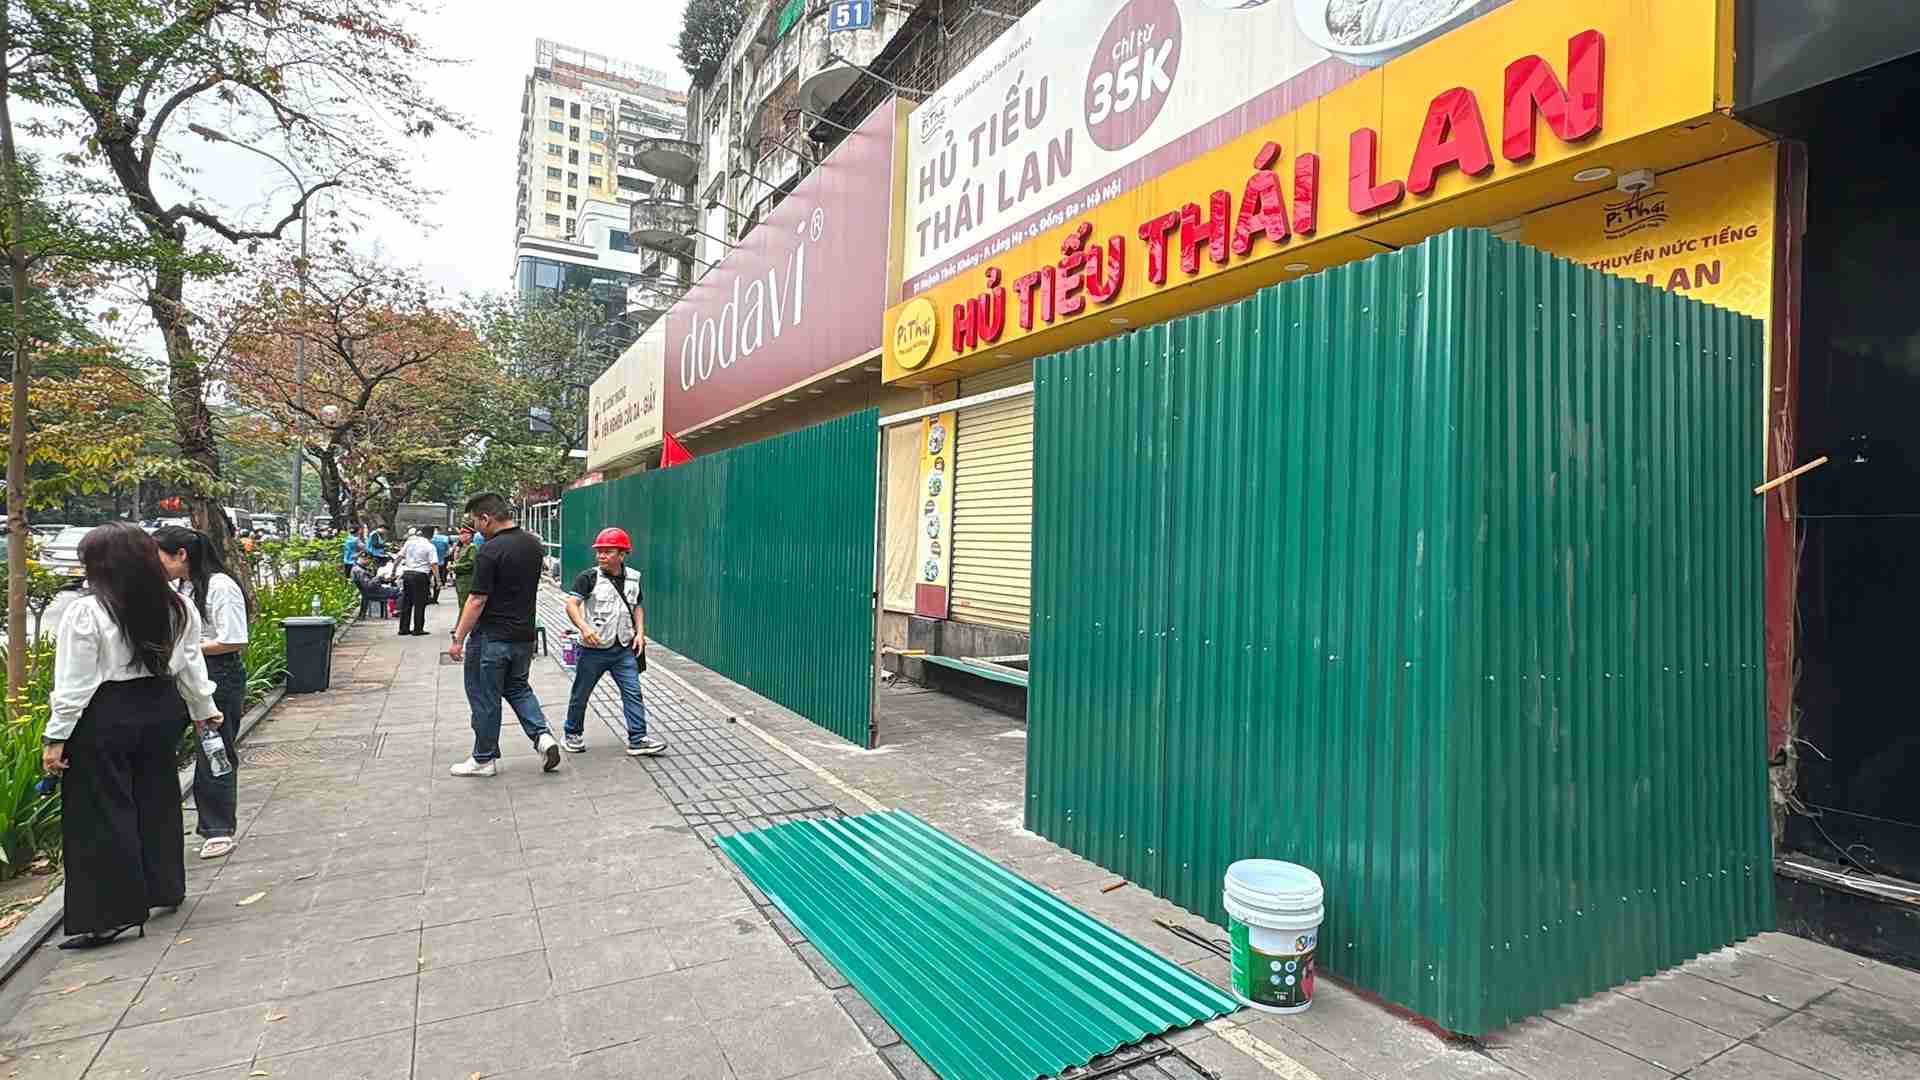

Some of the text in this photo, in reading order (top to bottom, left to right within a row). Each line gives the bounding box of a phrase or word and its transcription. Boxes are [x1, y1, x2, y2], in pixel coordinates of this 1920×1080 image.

[836, 3, 863, 26] 51
[1088, 38, 1174, 125] 35K
[918, 69, 1048, 204] HỦ TIẾU
[916, 127, 1073, 257] THÁI LAN
[953, 29, 1604, 353] HỦ TIẾU THÁI LAN
[1102, 177, 1120, 201] Nội
[1658, 239, 1698, 259] NỨC
[1701, 225, 1758, 248] TIẾNG
